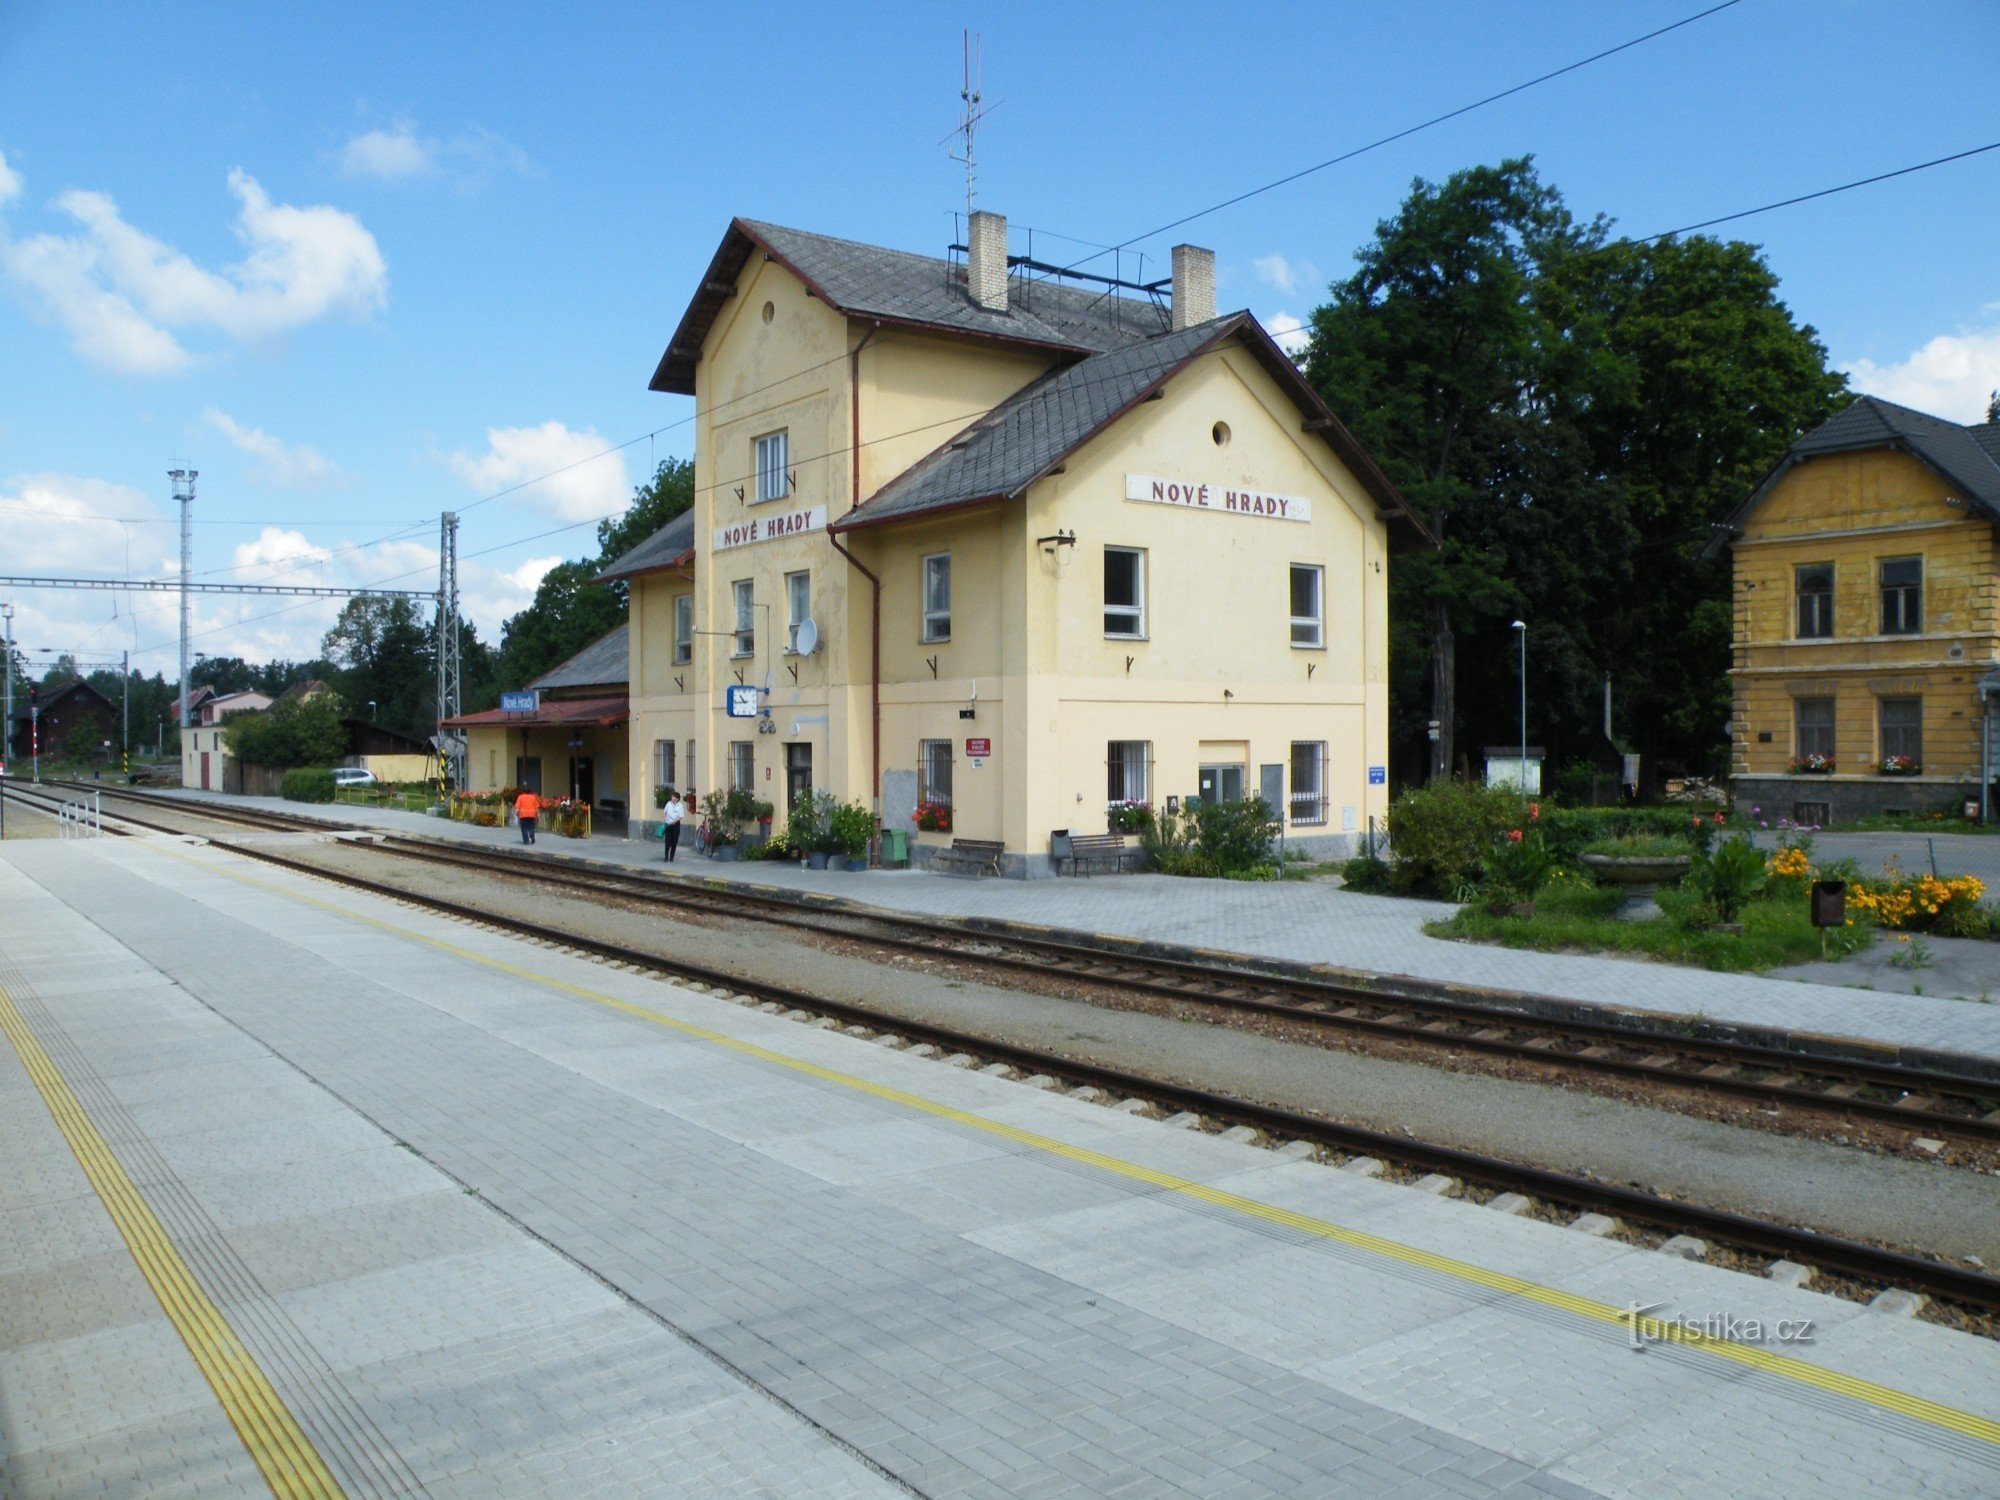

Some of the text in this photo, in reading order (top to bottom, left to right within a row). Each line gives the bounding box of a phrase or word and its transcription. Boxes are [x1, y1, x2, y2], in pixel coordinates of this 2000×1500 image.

[1152, 481, 1288, 516] NOVÉ HRADY
[724, 511, 812, 546] NOVÉ HRADY
[517, 695, 534, 711] Hrady
